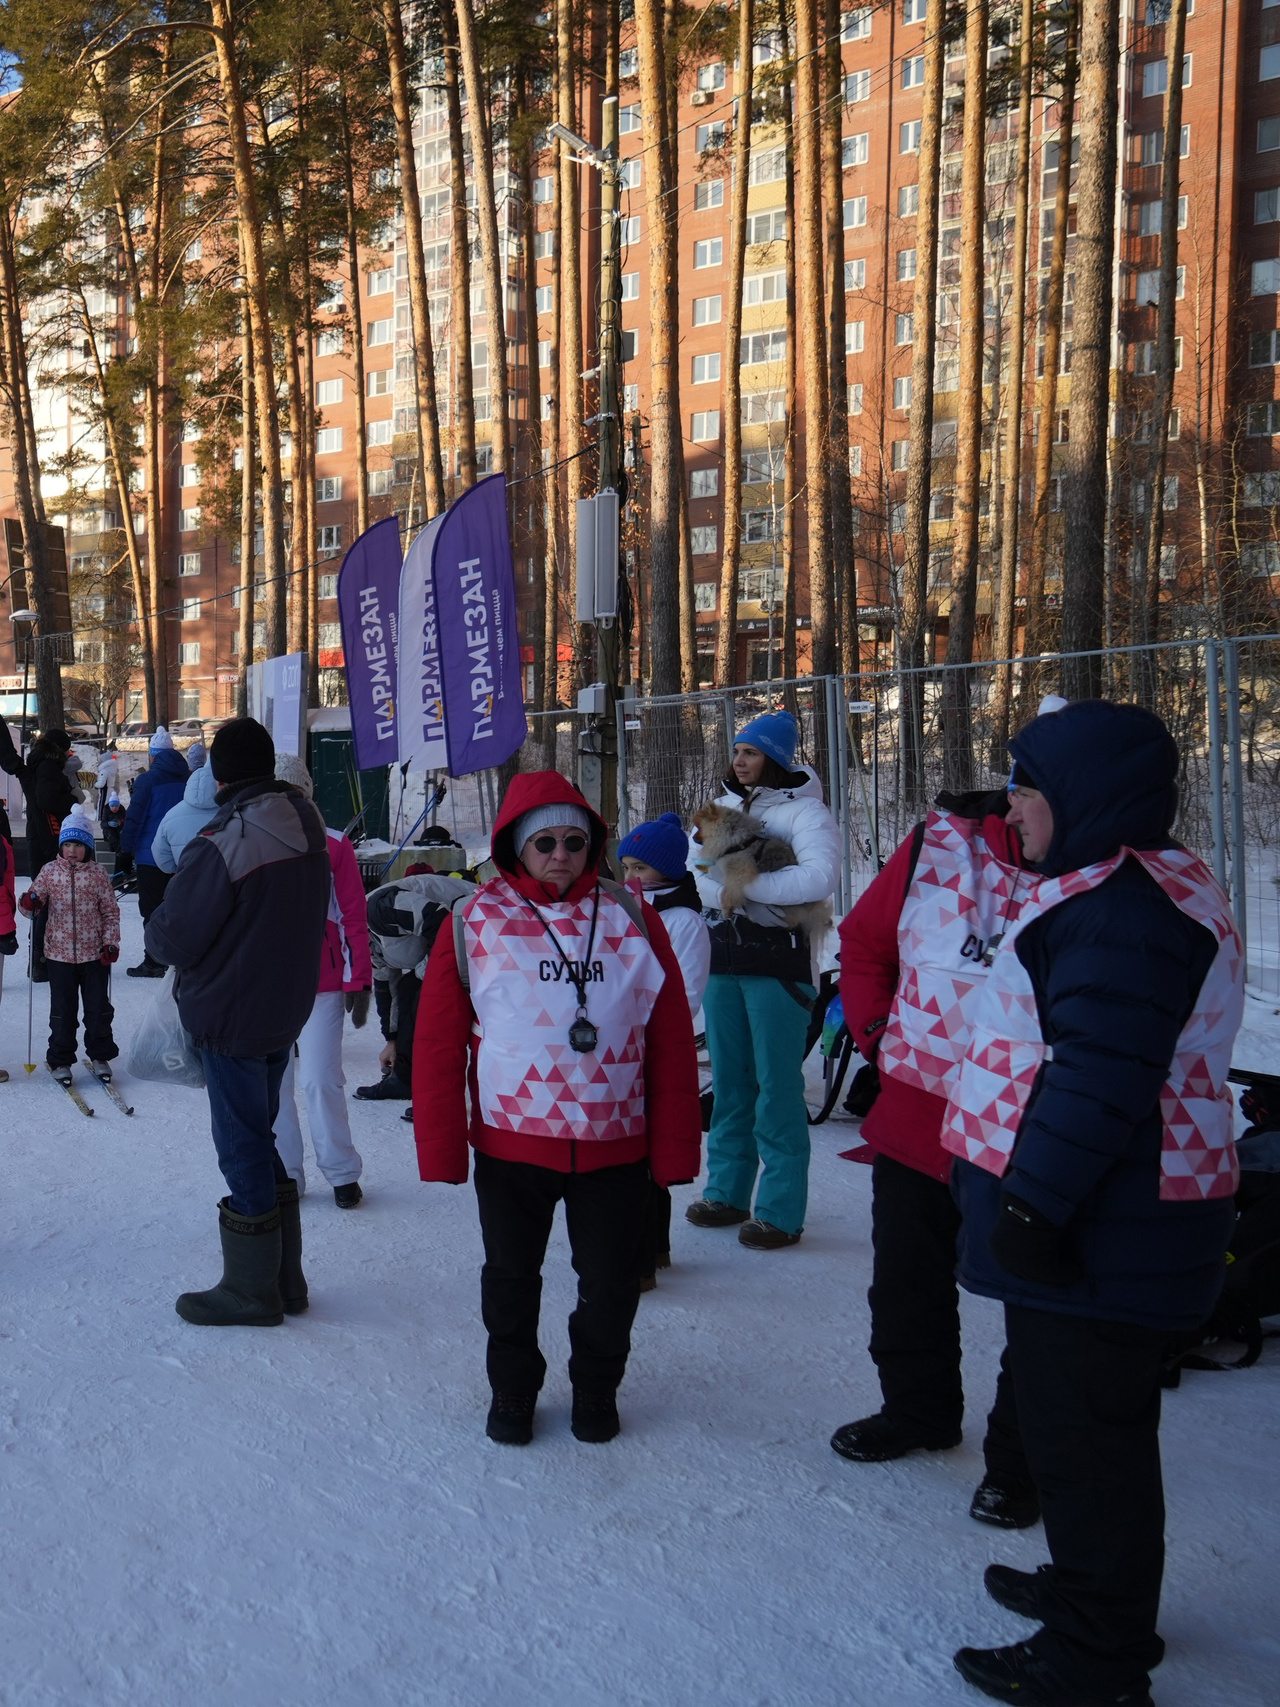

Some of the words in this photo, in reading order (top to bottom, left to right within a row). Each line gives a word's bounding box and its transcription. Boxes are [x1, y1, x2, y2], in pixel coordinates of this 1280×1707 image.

[492, 589, 501, 626] пицца
[388, 612, 398, 643] пицца
[359, 586, 394, 741] ПАРМЕЗАН
[458, 558, 494, 741] ПАРМЕЗАН
[539, 960, 604, 984] СУДЬЯ
